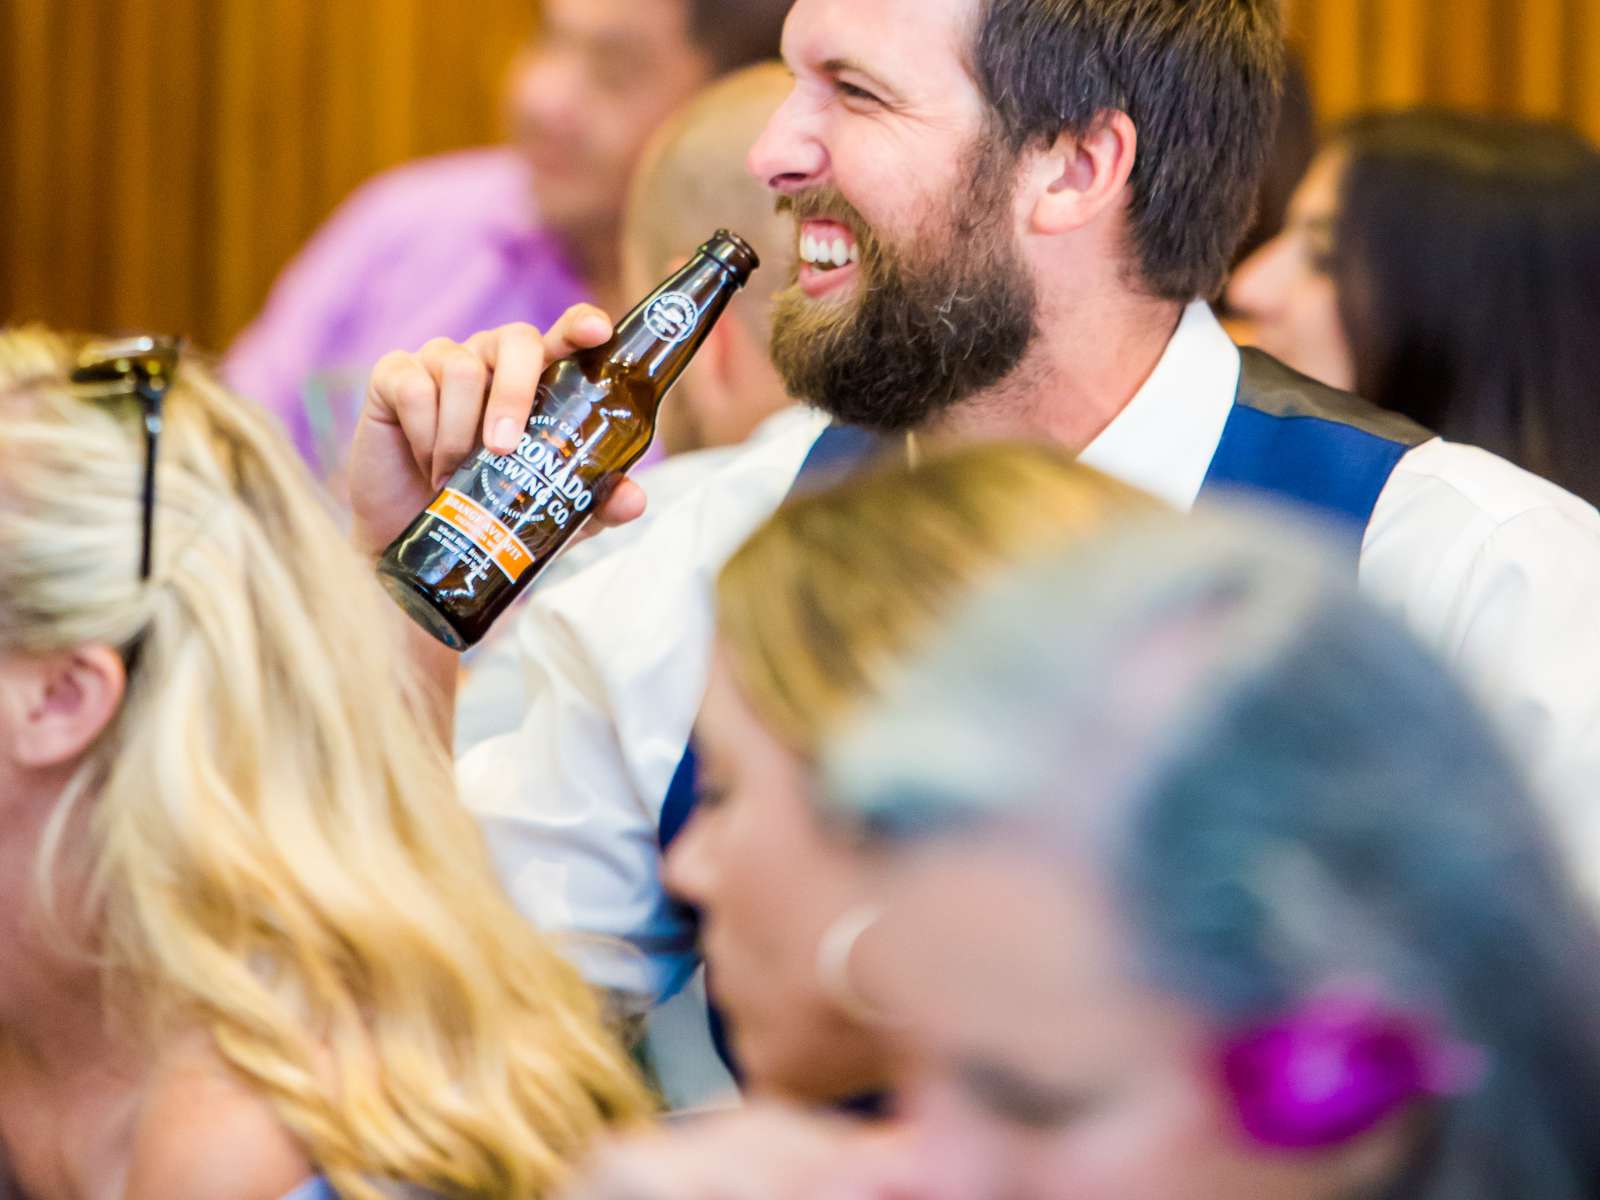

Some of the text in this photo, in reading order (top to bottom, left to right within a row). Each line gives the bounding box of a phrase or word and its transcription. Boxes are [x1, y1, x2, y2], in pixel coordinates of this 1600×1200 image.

[529, 415, 558, 427] STAY
[516, 432, 592, 512] RONADO
[547, 499, 569, 530] CO.
